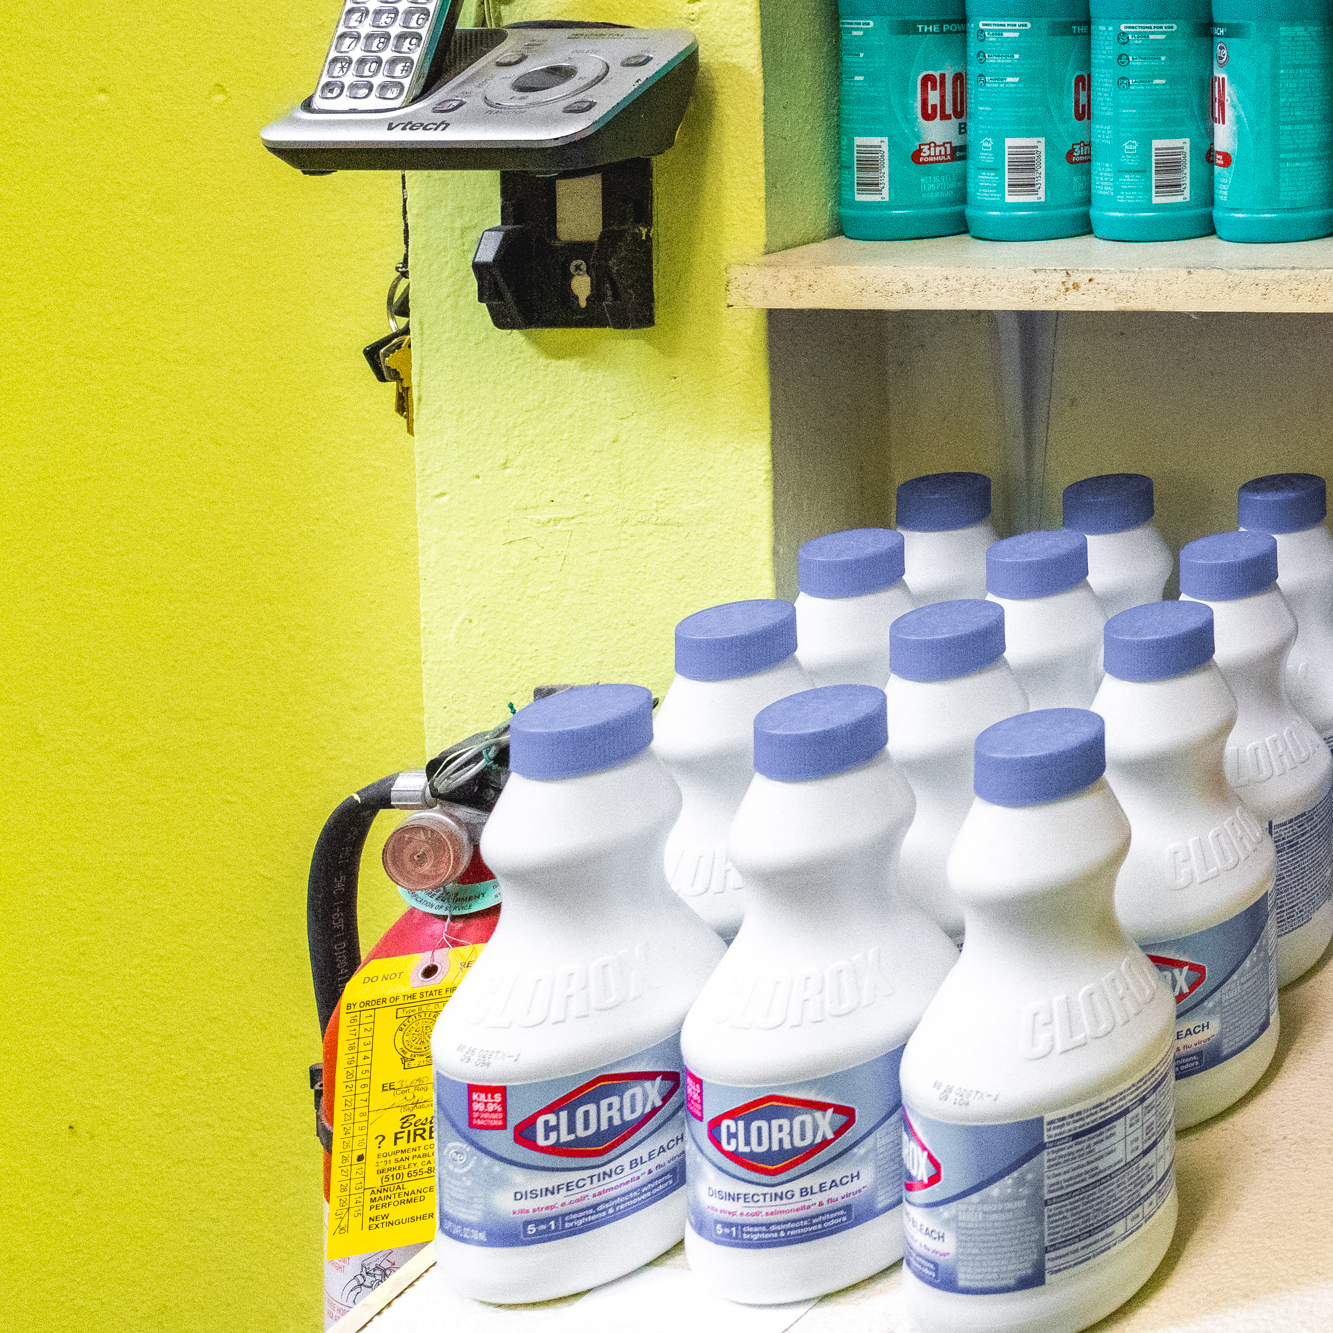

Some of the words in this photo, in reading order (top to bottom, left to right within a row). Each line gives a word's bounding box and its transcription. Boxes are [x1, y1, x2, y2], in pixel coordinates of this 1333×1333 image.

[386, 120, 450, 132] vtech
[362, 975, 380, 984] DO
[381, 972, 404, 981] NOT
[346, 1002, 358, 1010] BY
[359, 997, 387, 1008] ORDER
[389, 996, 400, 1004] OF
[403, 992, 417, 1002] THE
[419, 989, 443, 999] STATE
[472, 1092, 502, 1102] KILLS
[472, 1103, 502, 1111] 99.9%
[536, 1075, 663, 1147] CLOROX
[721, 1107, 835, 1153] CLOROX
[377, 1147, 412, 1159] EQUIPMENT
[376, 1162, 419, 1175] BERKELEY,
[514, 1165, 625, 1201] DISINFECTING
[629, 1133, 685, 1171] BLEACH
[380, 1174, 404, 1185] (510)
[370, 1184, 407, 1196] ANNUAL
[708, 1186, 795, 1204] DISINFECTING
[800, 1170, 861, 1197] BLEACH
[370, 1186, 434, 1203] MAINTENANCE
[369, 1195, 426, 1211] PERFORMED
[368, 1213, 390, 1223] NEW
[368, 1213, 434, 1231] EXTINGUISHER
